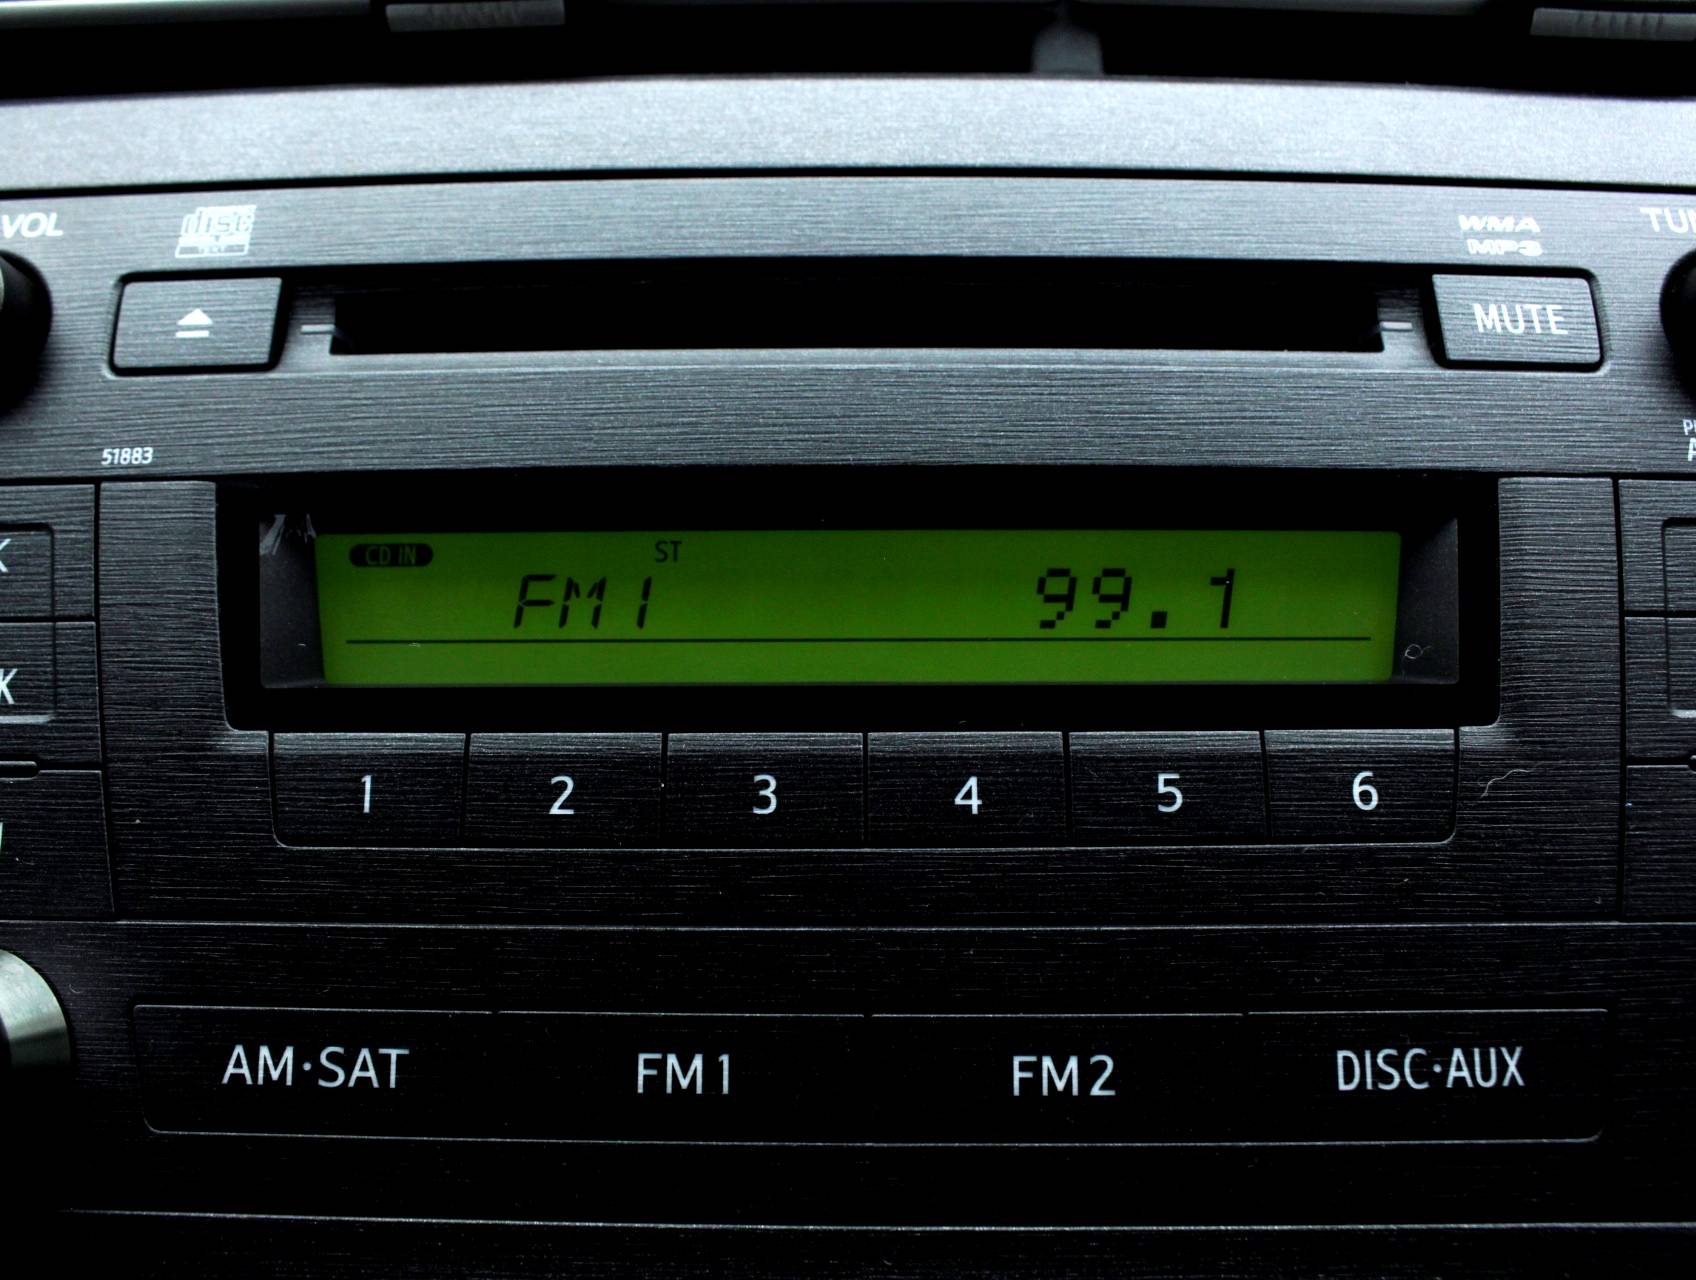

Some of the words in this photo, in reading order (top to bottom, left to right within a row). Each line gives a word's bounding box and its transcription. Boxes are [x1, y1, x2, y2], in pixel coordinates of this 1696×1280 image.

[1, 212, 64, 239] VOL
[1458, 214, 1541, 233] WMA
[1466, 238, 1544, 257] MP3
[1472, 302, 1569, 335] MUTE
[100, 446, 154, 466] 51883
[365, 545, 391, 565] CD
[399, 545, 417, 565] IN
[654, 540, 682, 563] ST
[361, 774, 372, 813] 1
[548, 775, 575, 815] 2
[752, 774, 777, 815] 3
[954, 776, 983, 815] 4
[1157, 773, 1183, 813] 5
[1352, 770, 1379, 811] 6
